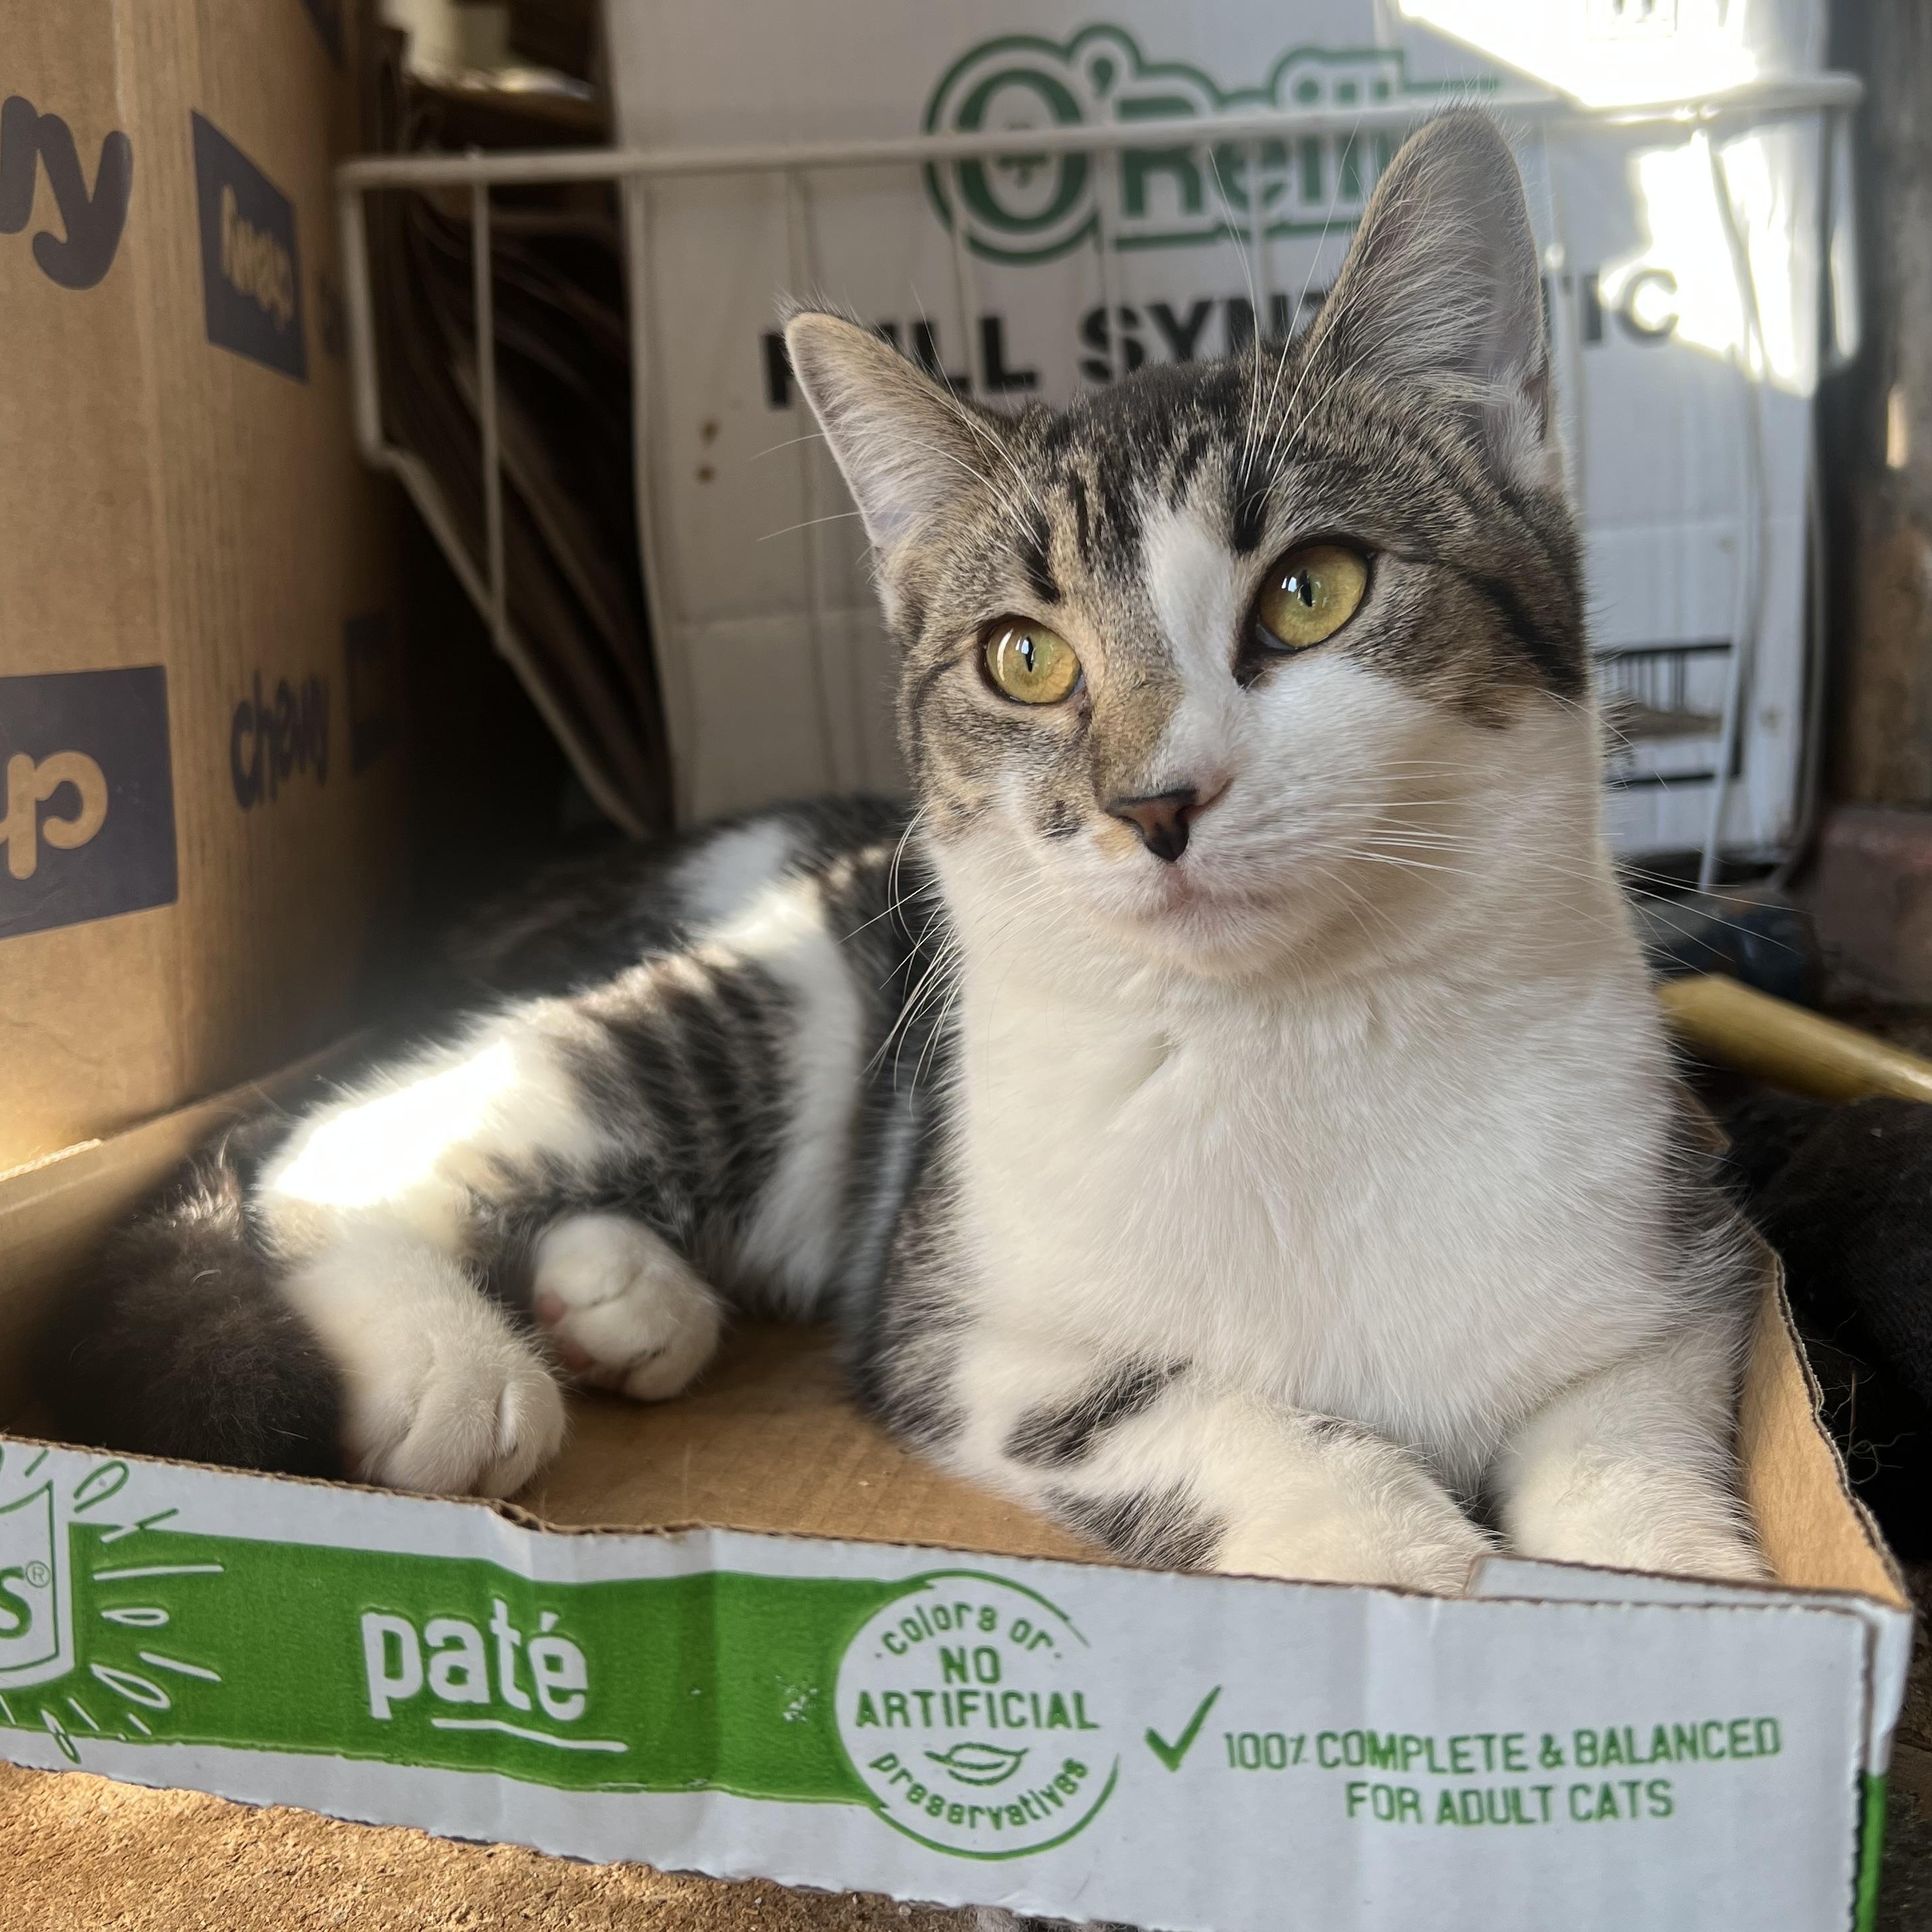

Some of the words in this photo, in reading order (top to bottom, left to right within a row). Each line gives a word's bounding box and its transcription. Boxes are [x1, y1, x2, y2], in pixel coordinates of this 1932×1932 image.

[881, 1602, 997, 1656] colors
[1009, 1619, 1053, 1652] or
[361, 1597, 588, 1721] paté
[938, 1645, 1002, 1685] NO
[855, 1689, 1099, 1730] ARTIFICIAL
[1224, 1732, 1308, 1772] 100%
[1317, 1730, 1529, 1775] COMPLETE
[1539, 1734, 1566, 1771] &
[1573, 1717, 1782, 1770] BALANCED
[869, 1752, 1089, 1830] preservatives
[1345, 1781, 1424, 1824] FOR
[1436, 1784, 1553, 1826] ADULT
[1568, 1778, 1673, 1822] CATS
